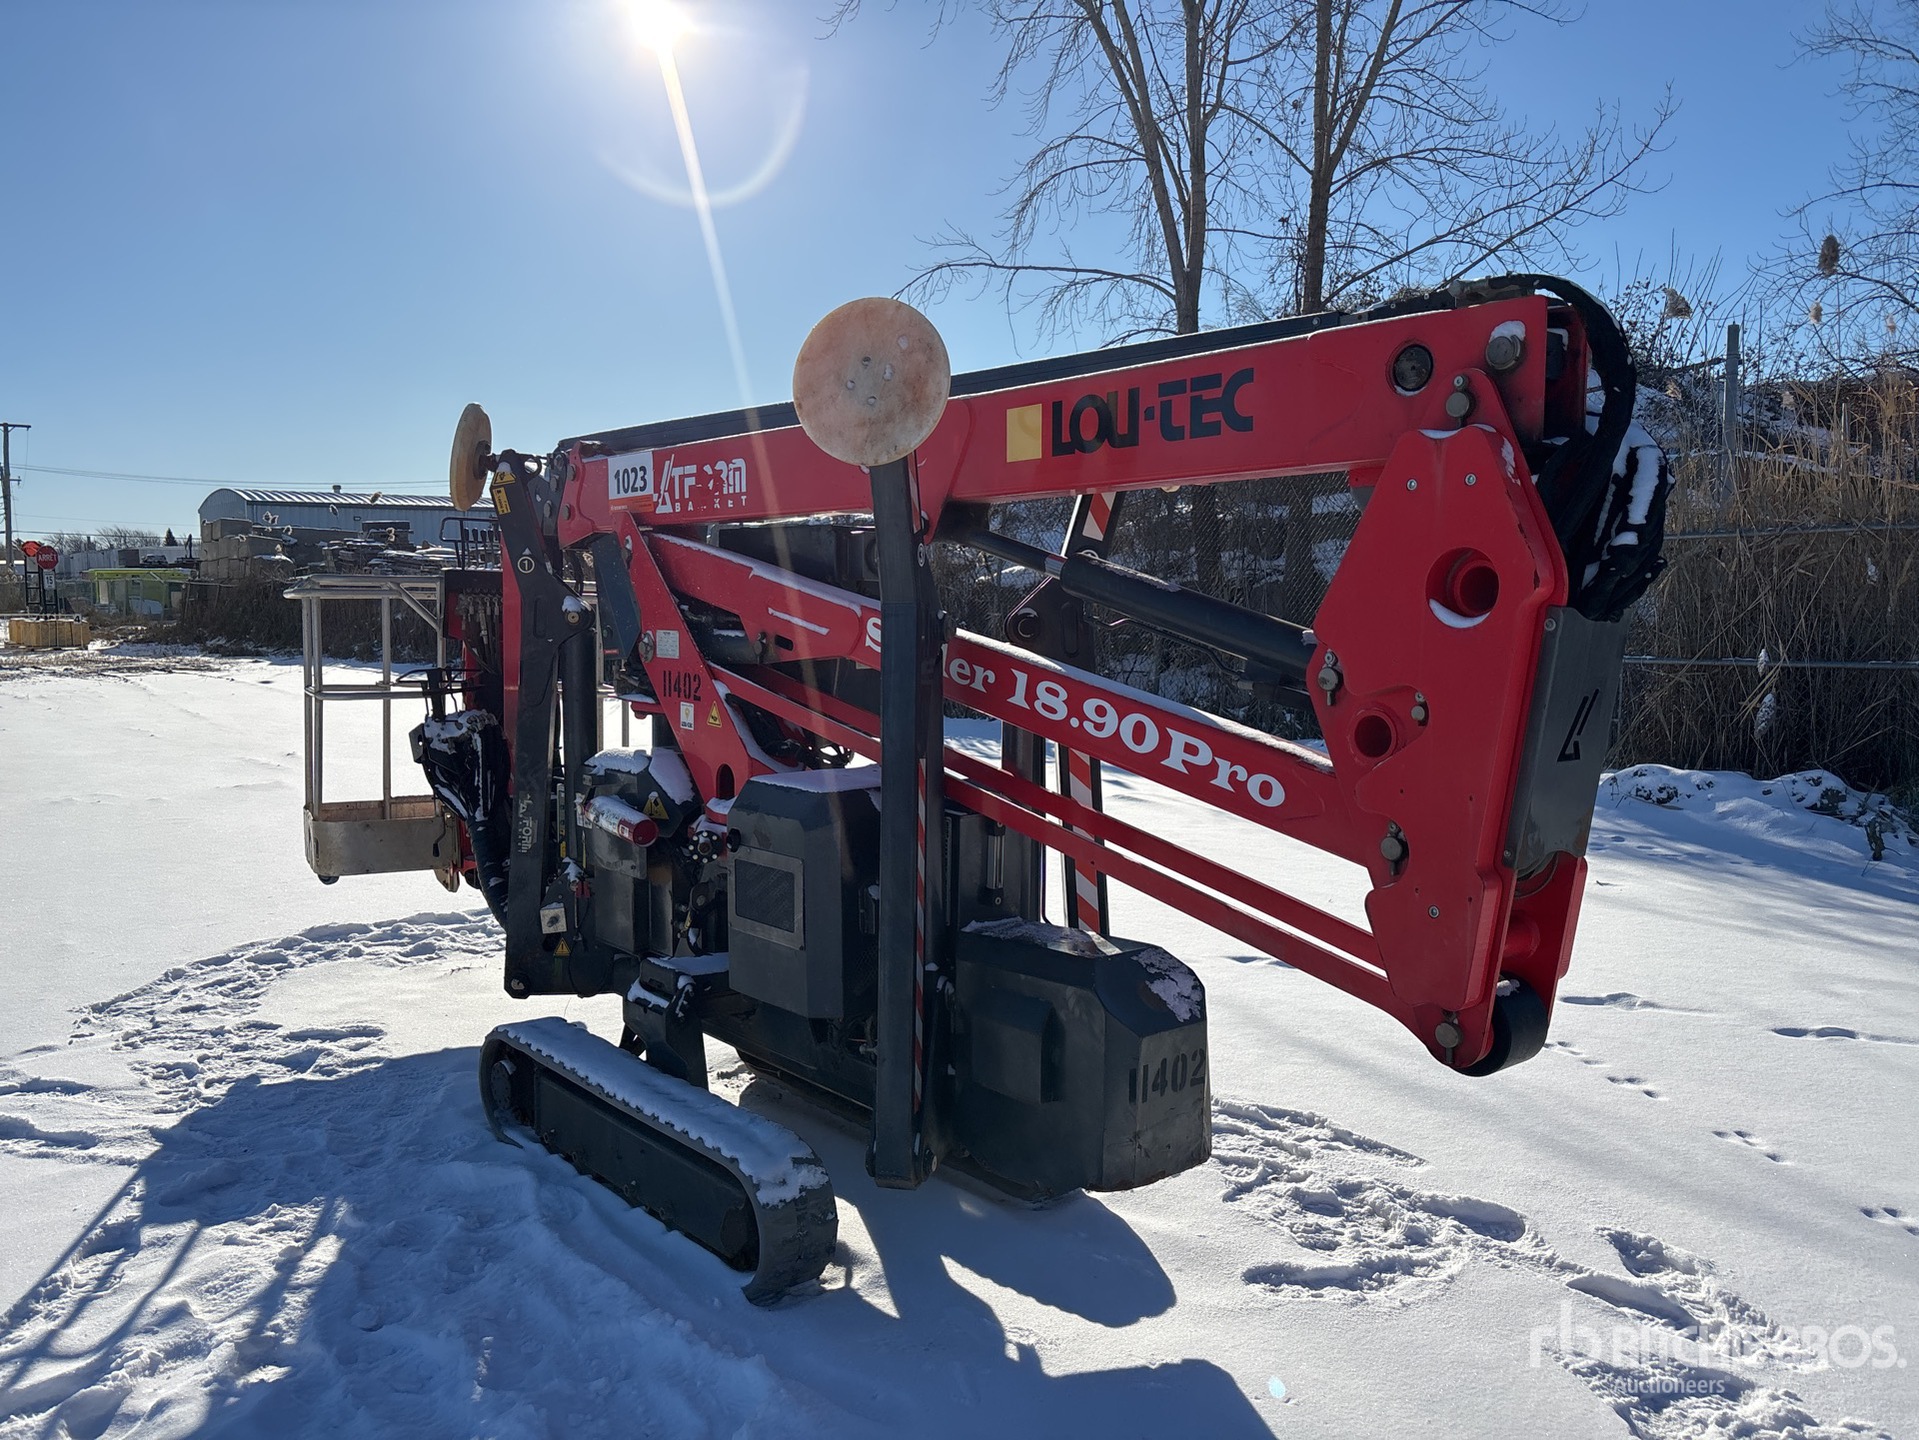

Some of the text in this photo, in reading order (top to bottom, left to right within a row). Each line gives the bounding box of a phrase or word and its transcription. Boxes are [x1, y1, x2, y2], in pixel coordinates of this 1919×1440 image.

[614, 465, 648, 495] 1023
[675, 495, 747, 513] BAKET
[46, 575, 54, 585] 15
[663, 670, 702, 702] 11402
[1128, 1047, 1206, 1106] 11402
